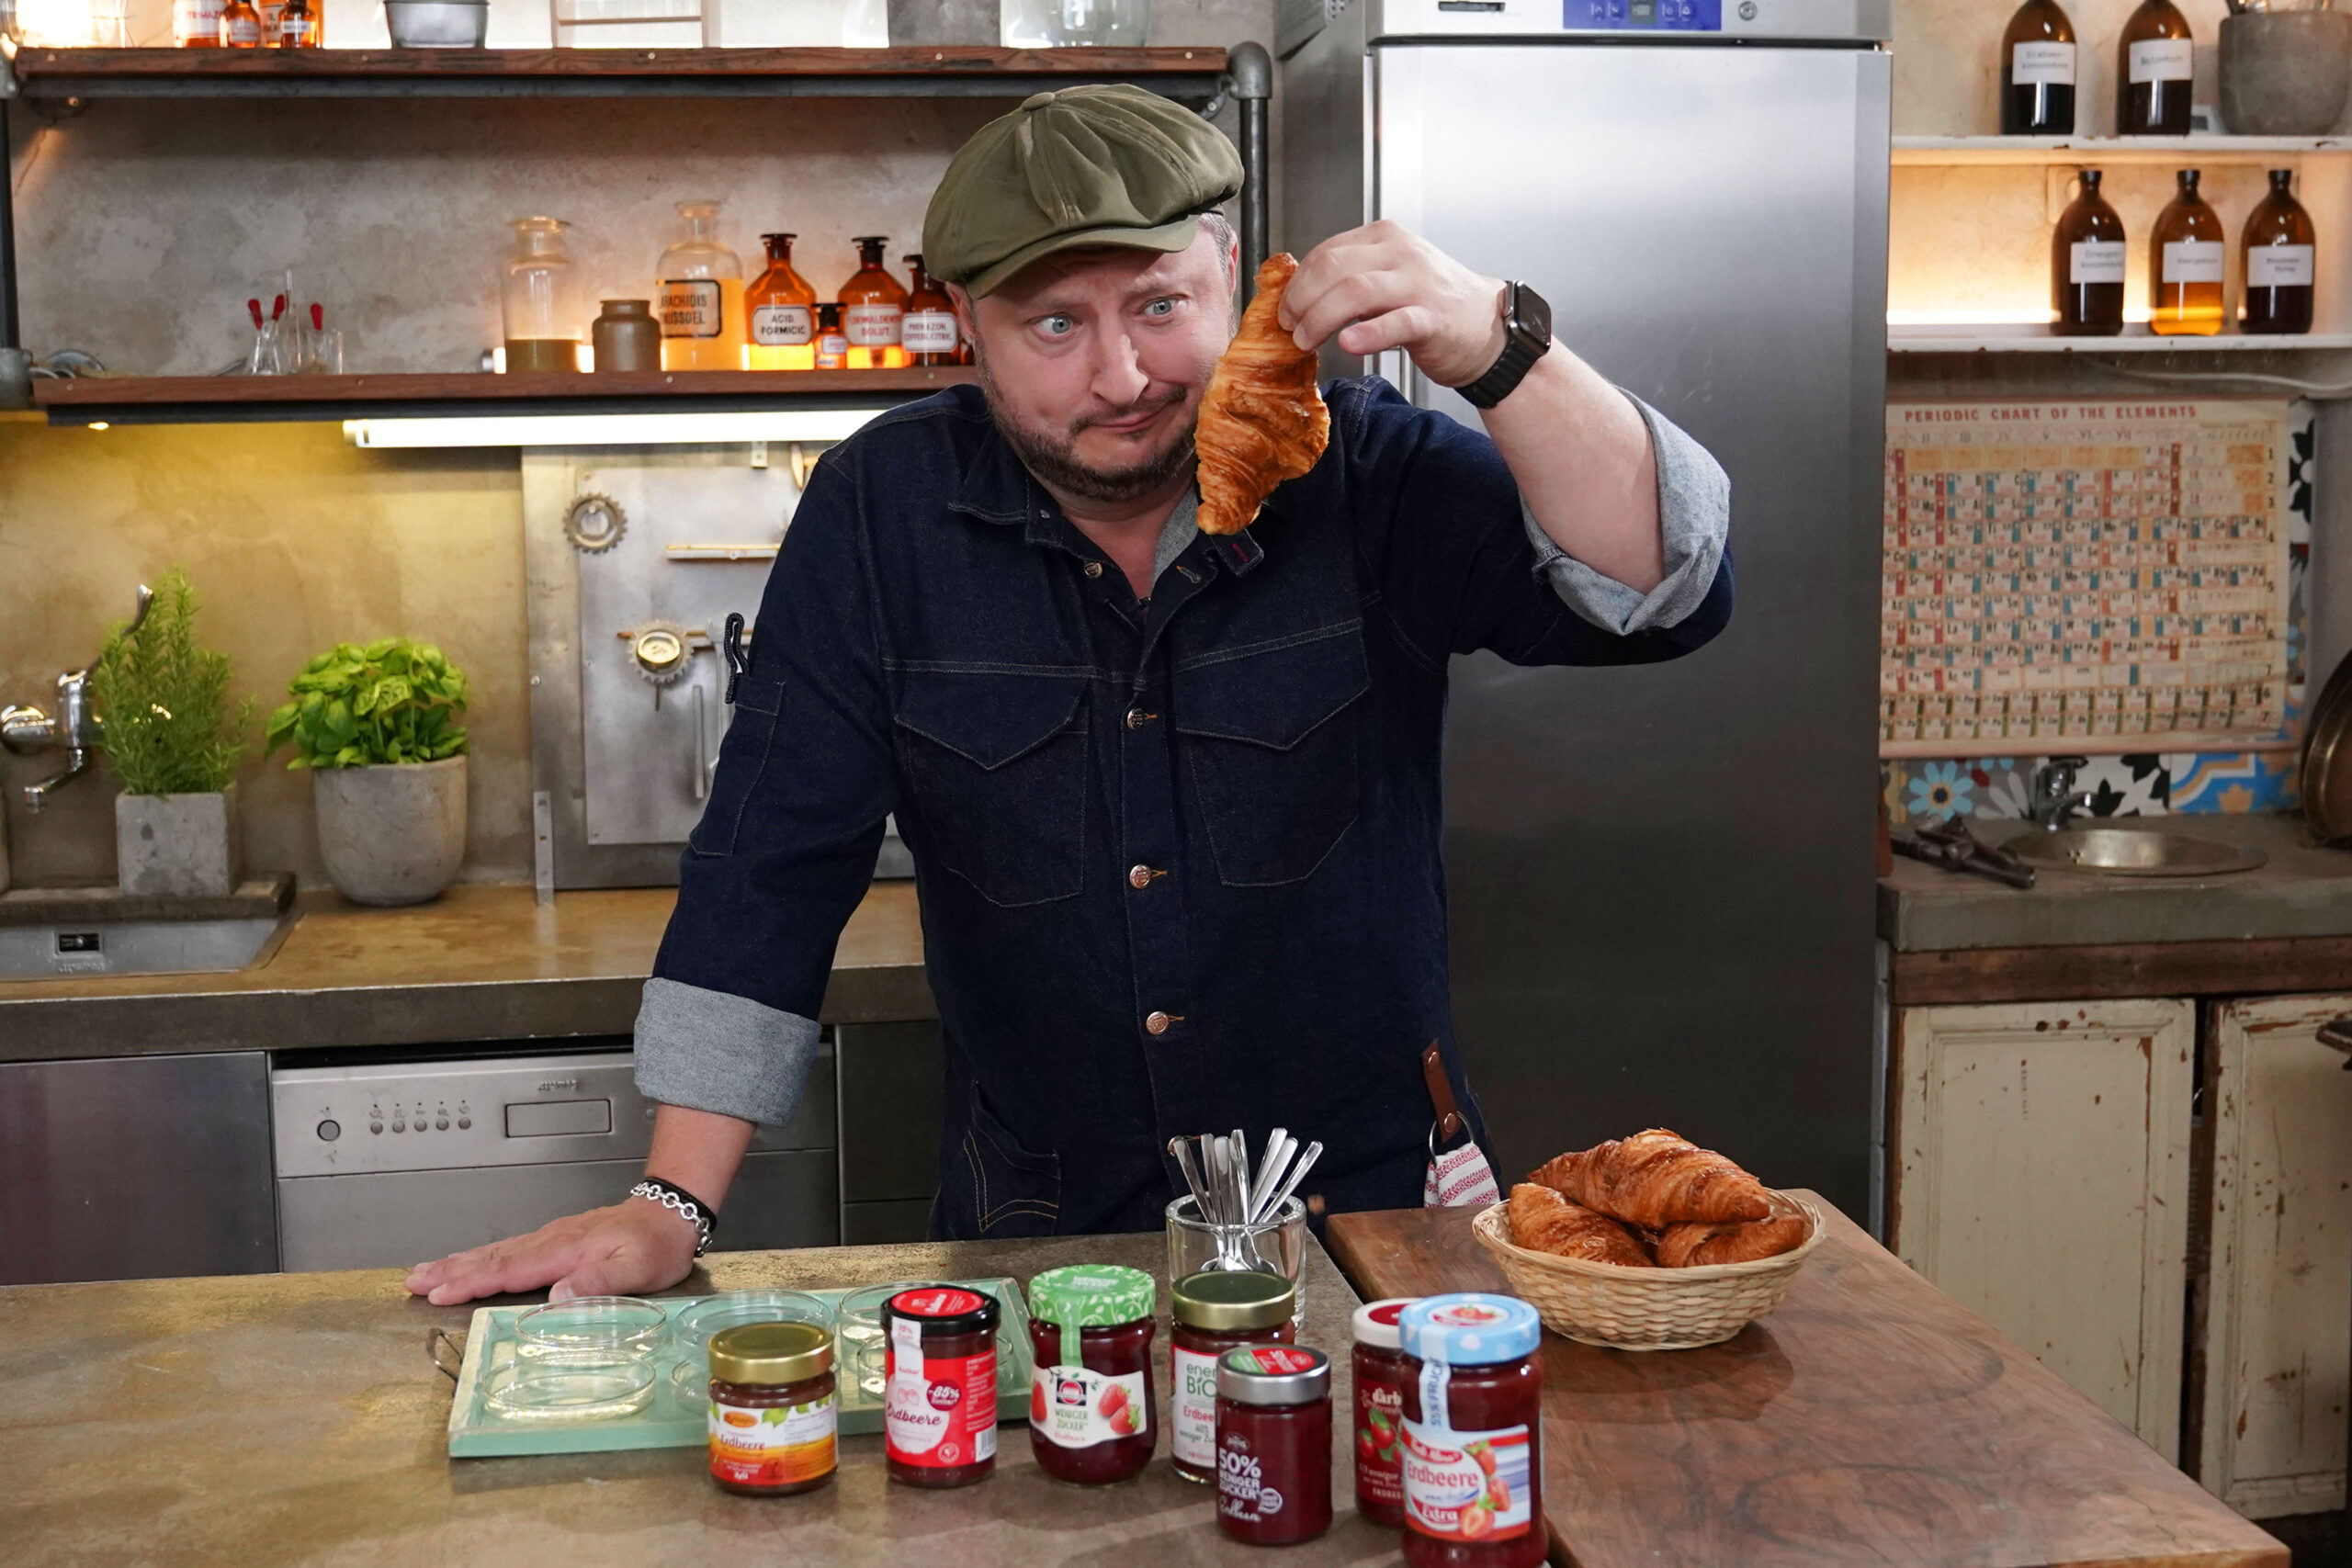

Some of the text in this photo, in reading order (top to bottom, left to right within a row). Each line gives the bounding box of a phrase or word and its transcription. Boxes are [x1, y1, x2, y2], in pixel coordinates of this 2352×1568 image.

[1905, 406, 2196, 423] PERIODIC CHART OF THE ELEMENTS
[928, 1384, 960, 1399] -85%
[887, 1401, 942, 1426] Erdbeere
[1055, 1407, 1089, 1419] WENIGER
[1182, 1404, 1215, 1422] Erdbee
[719, 1433, 765, 1451] Erdbeere
[1219, 1447, 1262, 1480] 50%
[1219, 1470, 1261, 1488] WENIGER
[1406, 1461, 1479, 1488] Erdbeere
[1421, 1504, 1459, 1523] Extra
